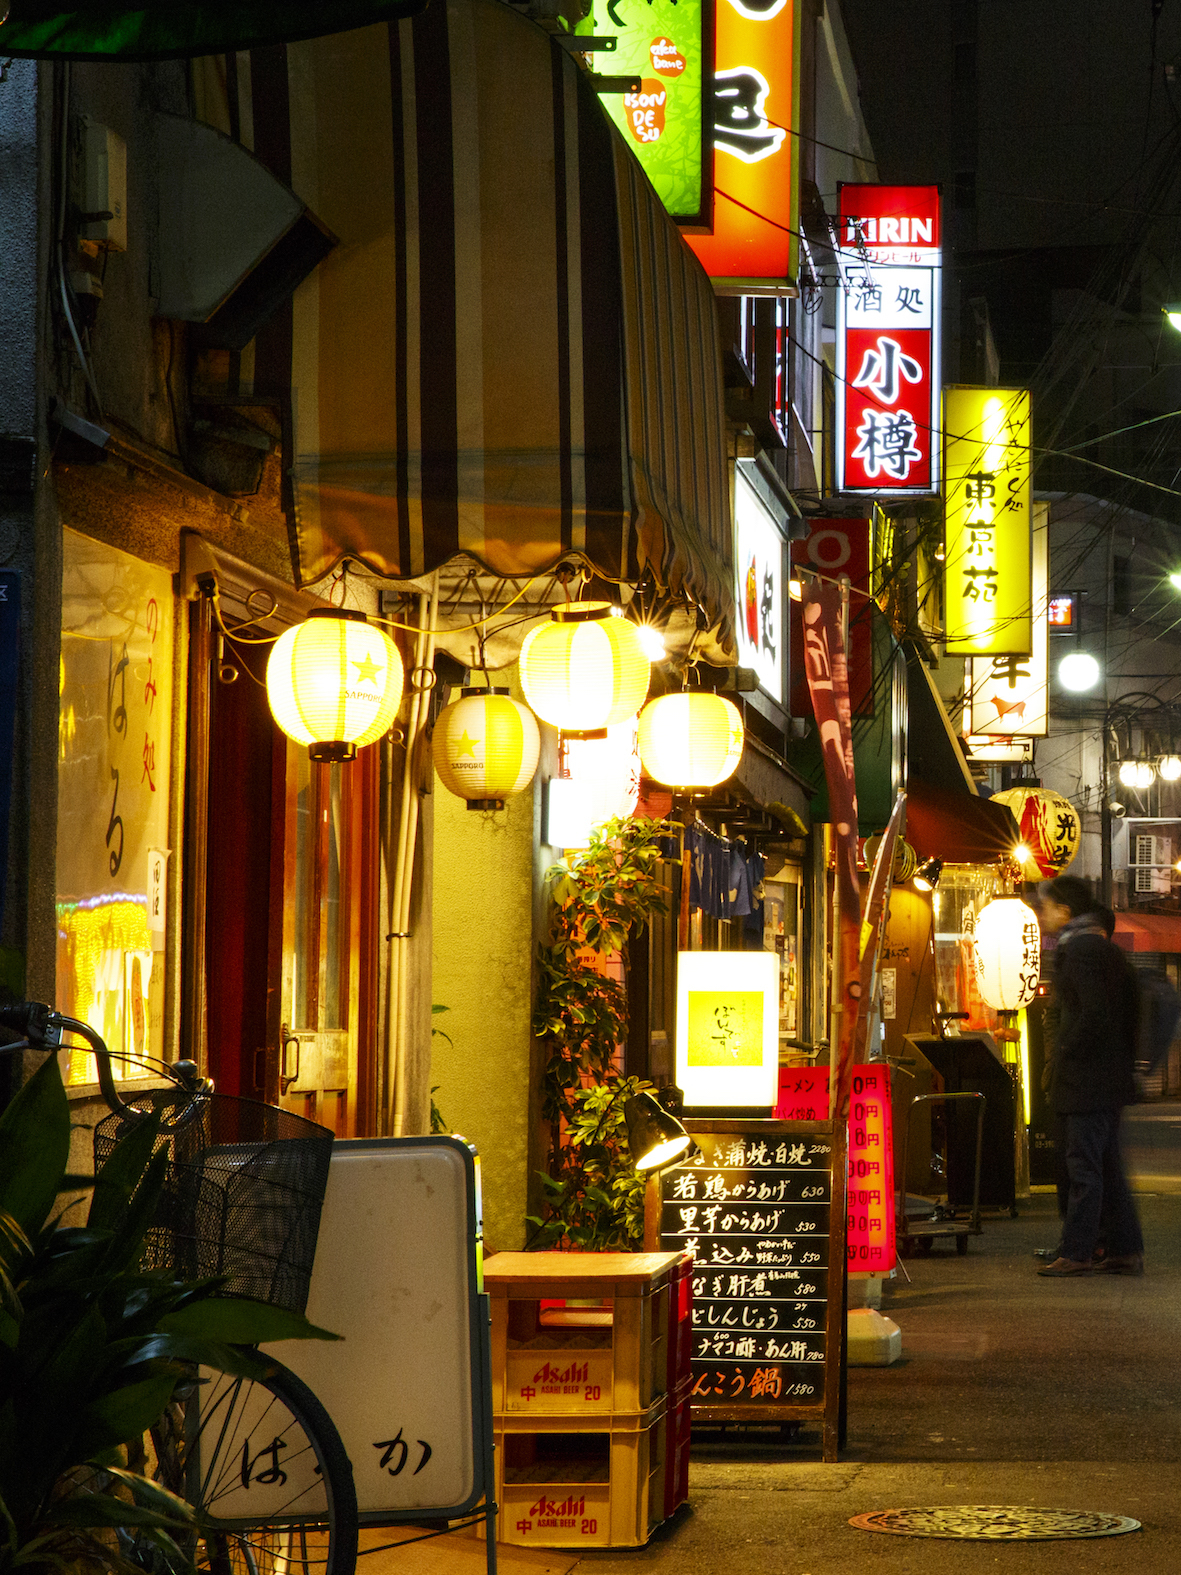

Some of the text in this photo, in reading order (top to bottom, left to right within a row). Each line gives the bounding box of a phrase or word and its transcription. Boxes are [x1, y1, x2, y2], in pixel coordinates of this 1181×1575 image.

[653, 56, 683, 70] bane
[633, 110, 655, 127] DE
[636, 126, 660, 142] SU
[847, 217, 932, 243] KIRIN
[851, 336, 922, 480] 小樽
[962, 470, 999, 603] 東京苑
[808, 1144, 832, 1155] 2280
[801, 1186, 825, 1198] 630
[795, 1221, 816, 1232] 530
[800, 1252, 821, 1264] 550
[794, 1283, 816, 1295] 580
[792, 1317, 816, 1329] 550
[713, 1332, 730, 1341] 600
[806, 1351, 825, 1361] 780
[533, 1362, 589, 1384] Asahi
[521, 1386, 601, 1401] 中 ASAHI BEER 20
[785, 1383, 815, 1396] 1580
[529, 1495, 585, 1517] Asahi
[516, 1519, 597, 1535] 中 ASAHI BEER 20
